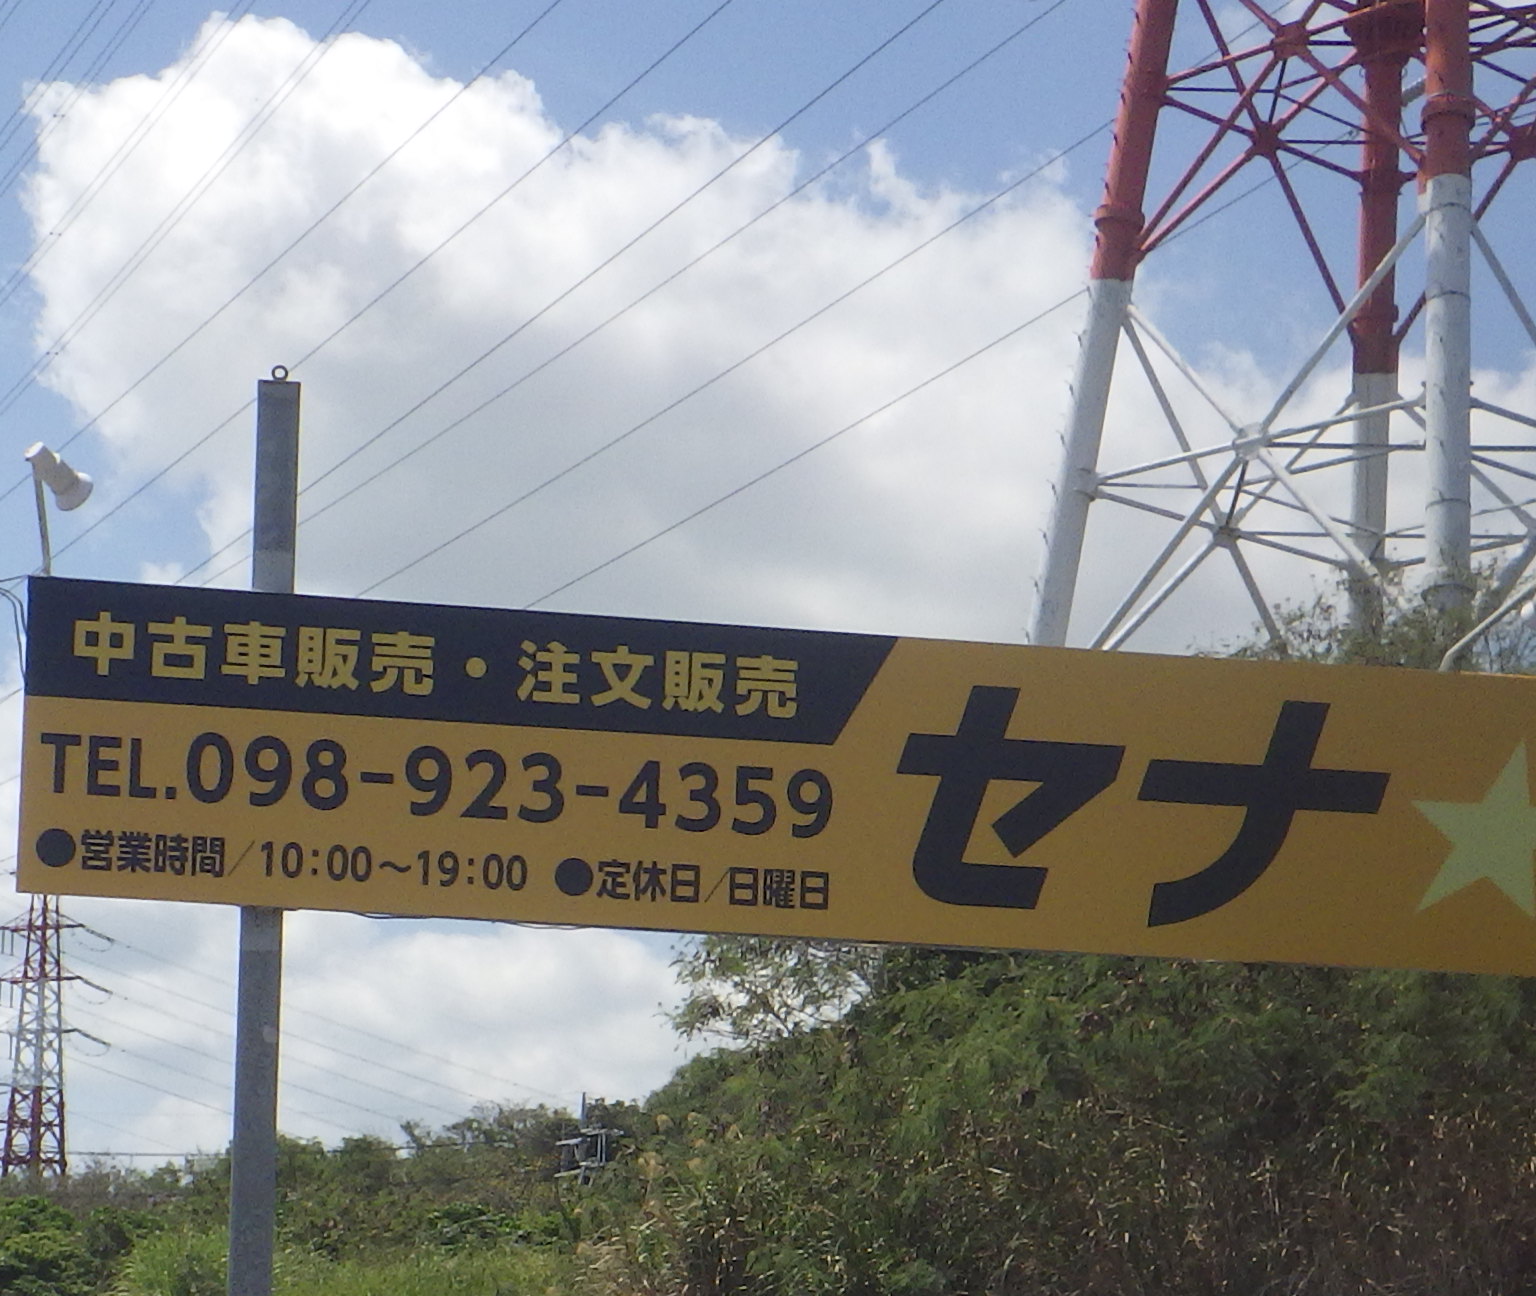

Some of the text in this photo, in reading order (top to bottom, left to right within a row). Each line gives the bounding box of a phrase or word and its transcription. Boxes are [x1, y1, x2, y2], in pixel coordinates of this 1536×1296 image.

[72, 610, 800, 719] 中古車販売・注文販売
